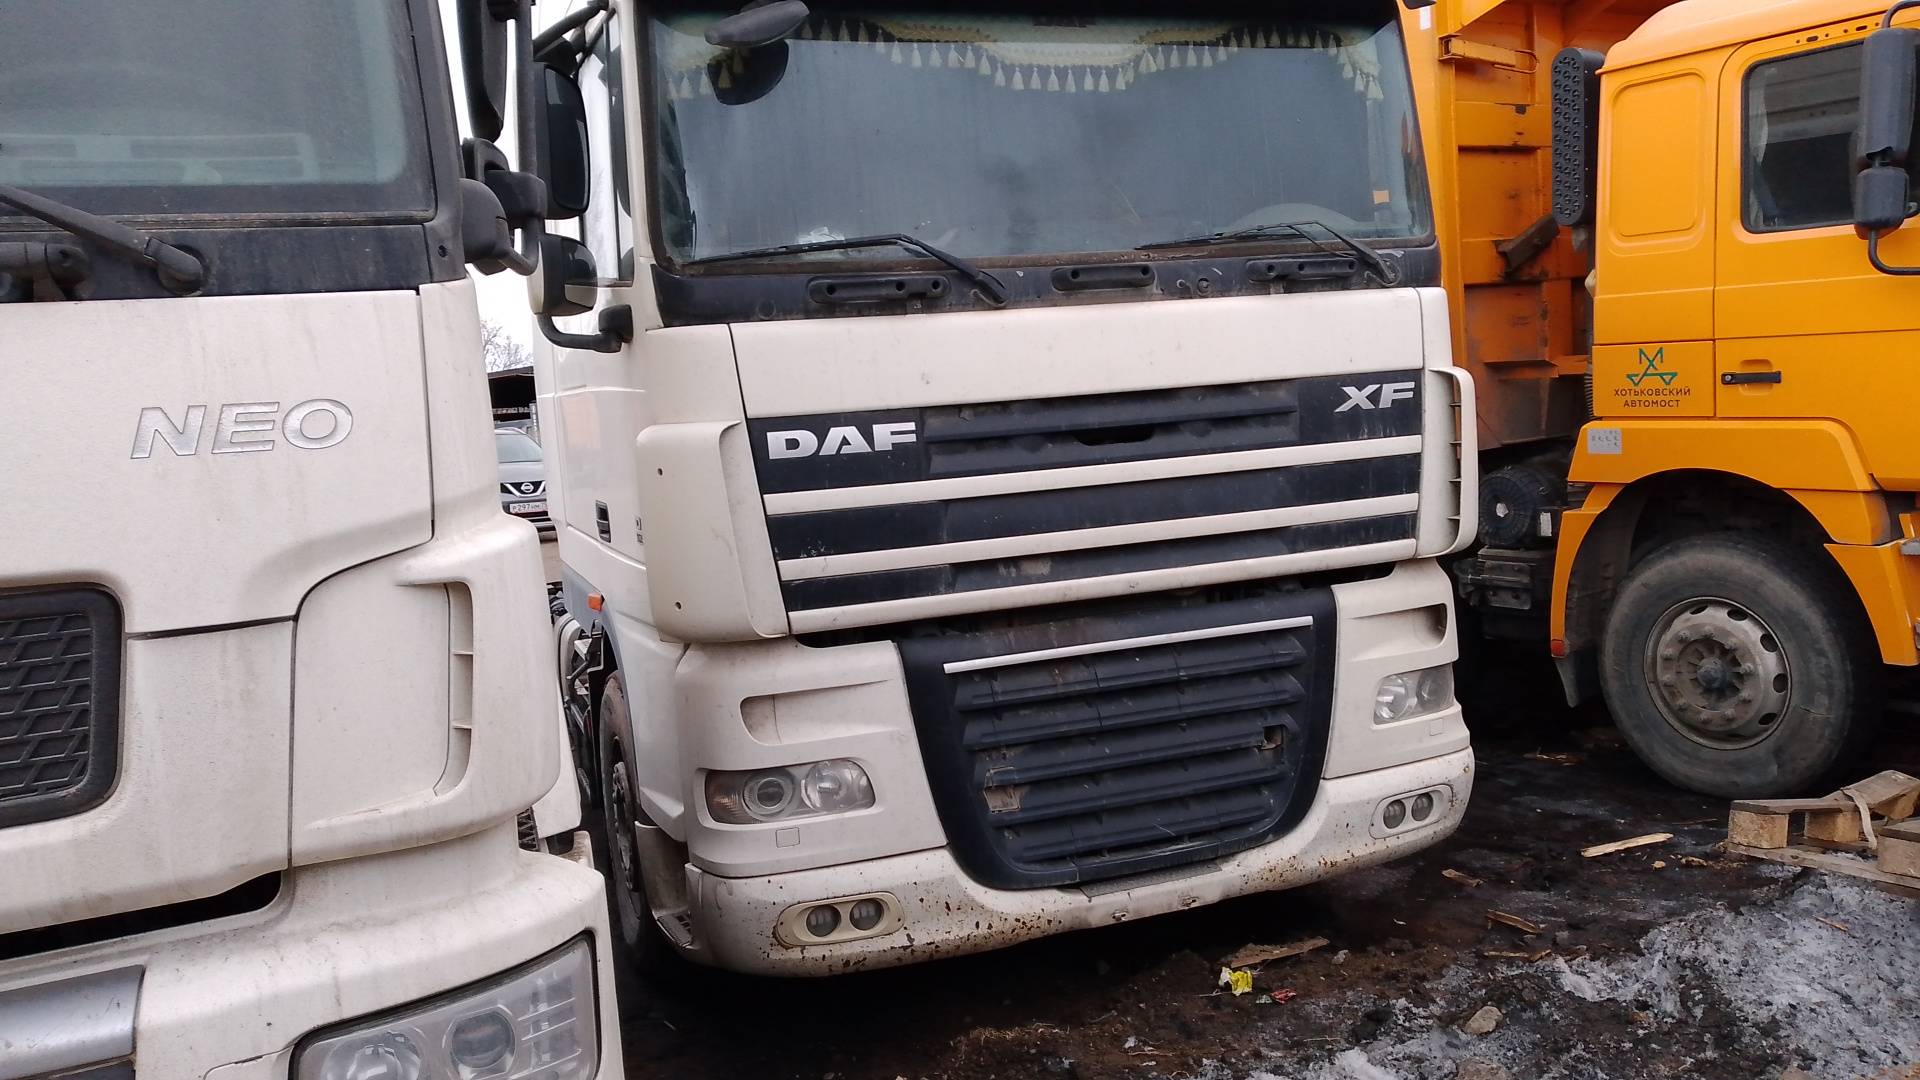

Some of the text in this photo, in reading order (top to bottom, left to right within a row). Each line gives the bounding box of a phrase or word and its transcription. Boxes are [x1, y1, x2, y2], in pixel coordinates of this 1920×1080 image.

[1333, 382, 1415, 412] XF
[1614, 386, 1691, 397] ХОТЬКОВСКИЙ
[1623, 399, 1681, 408] АВТОМОСТ
[130, 398, 353, 459] NEO
[766, 422, 917, 460] DAF
